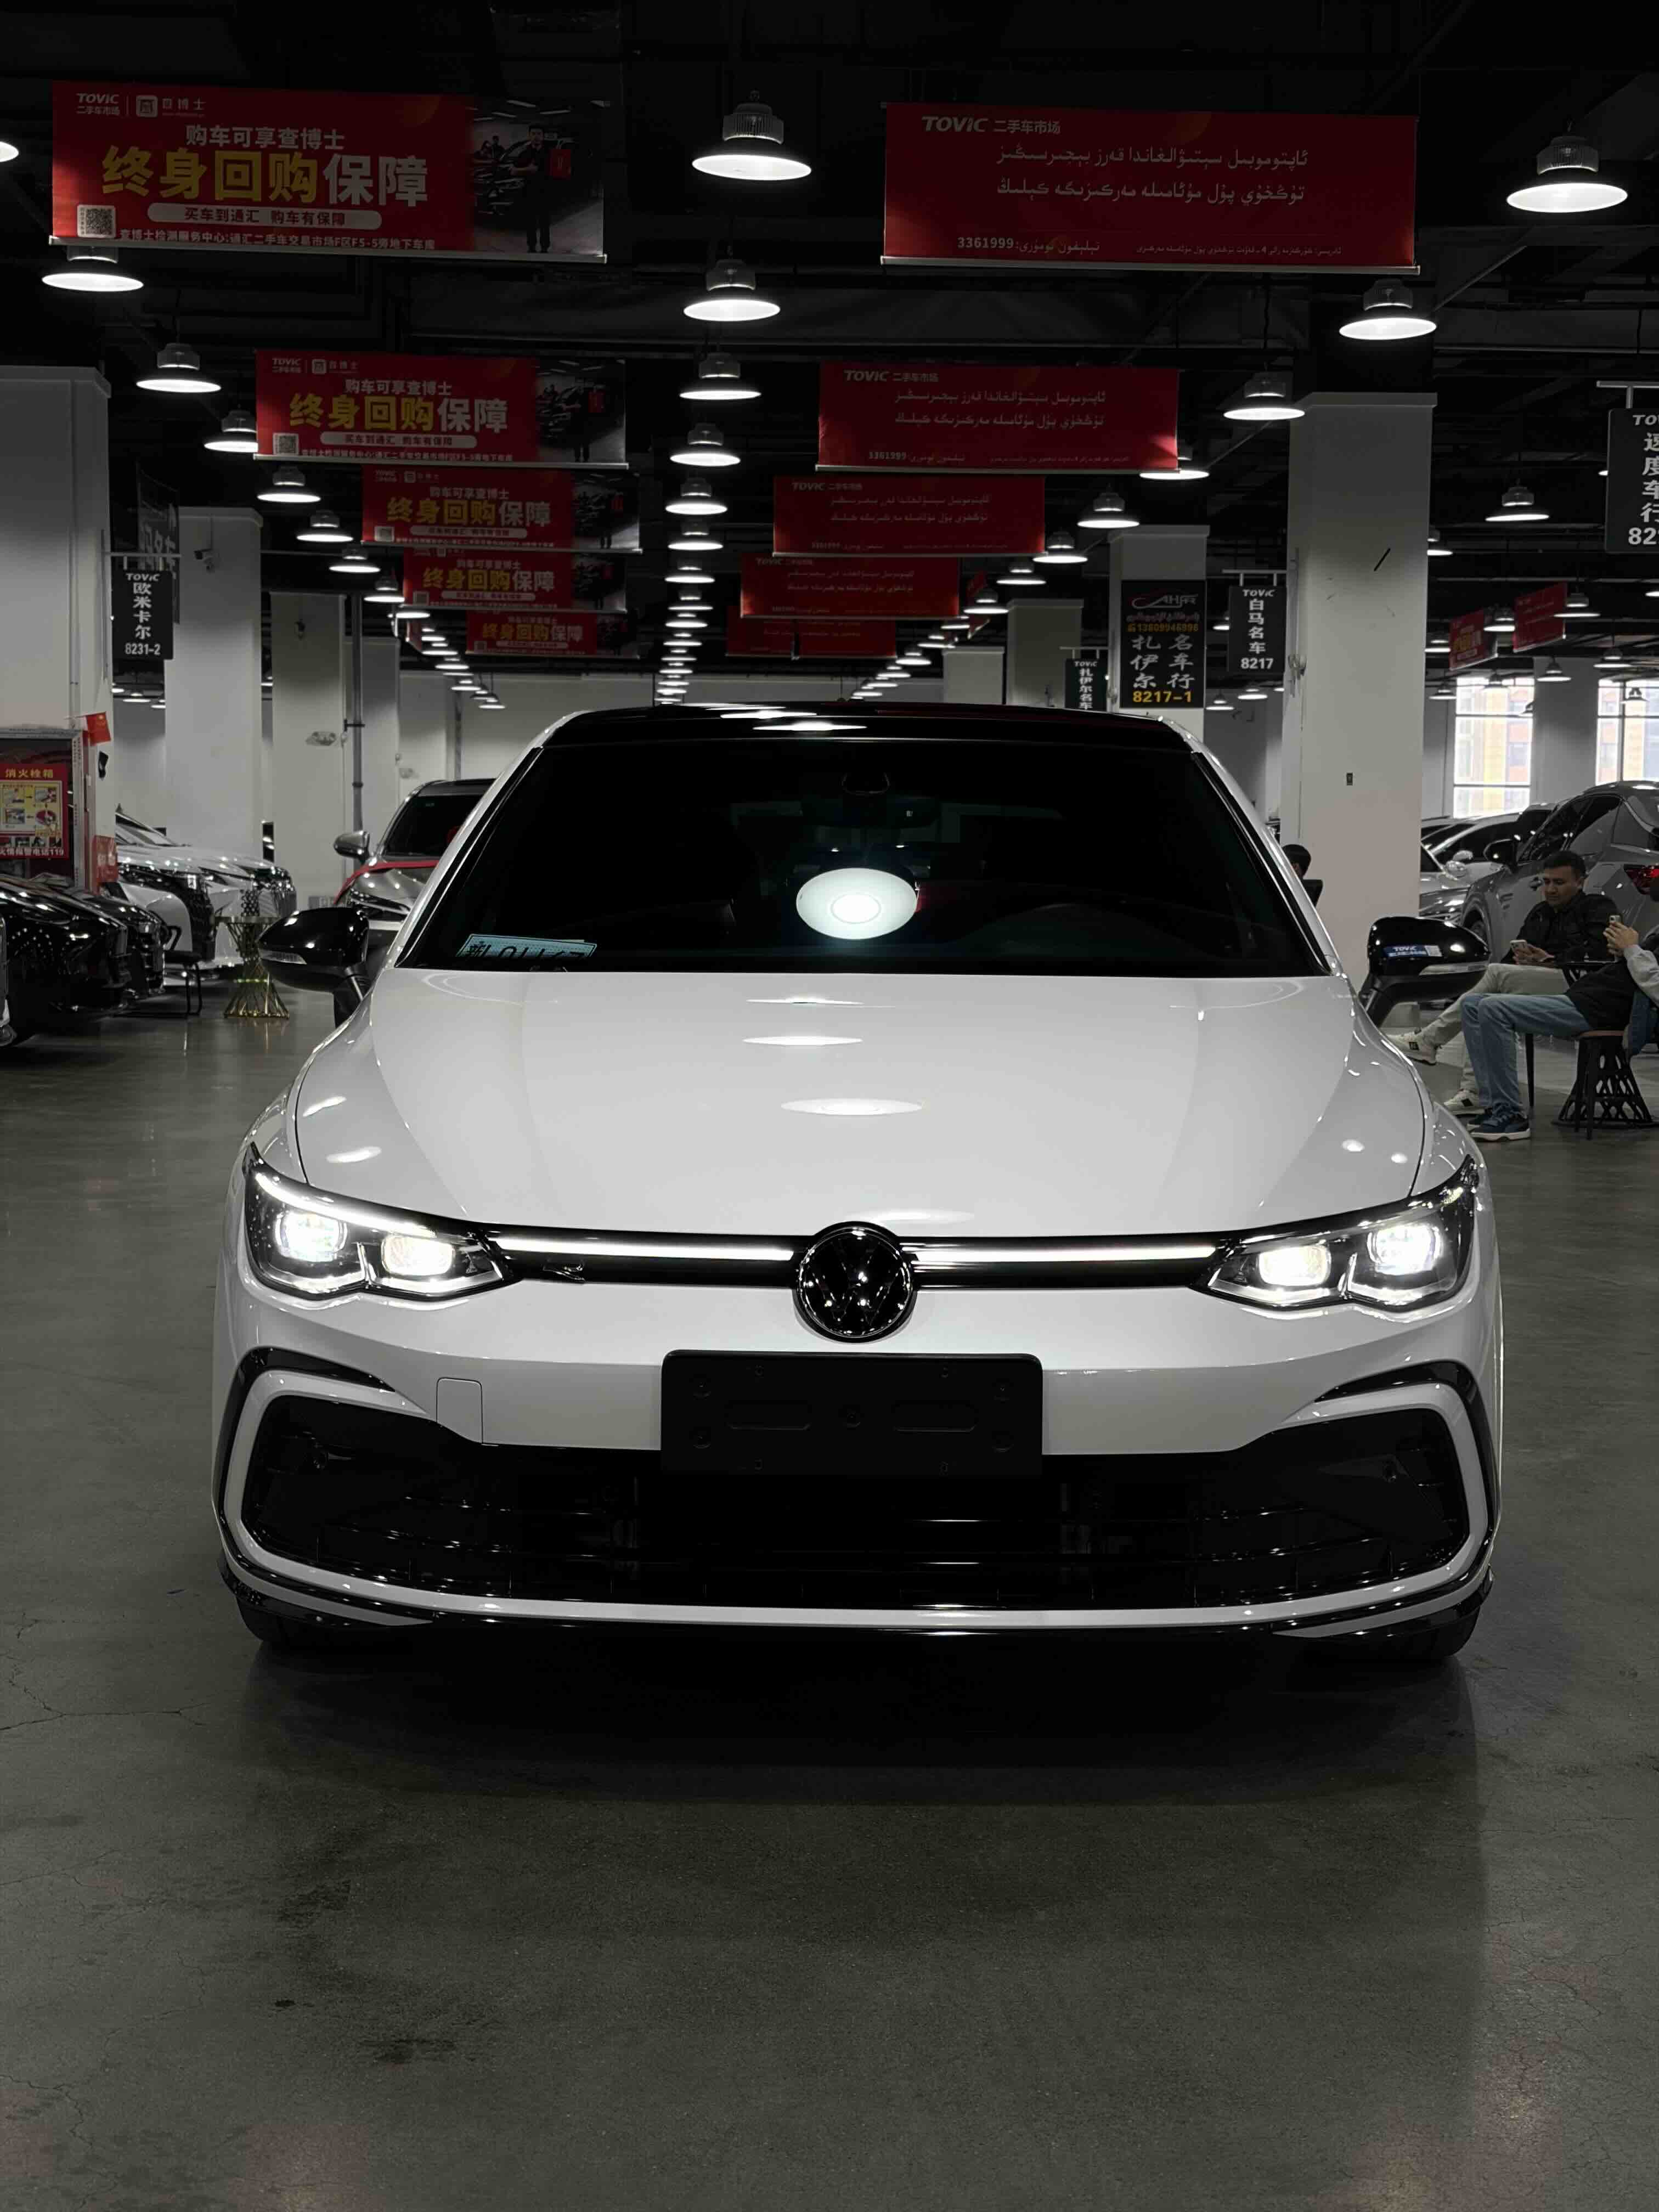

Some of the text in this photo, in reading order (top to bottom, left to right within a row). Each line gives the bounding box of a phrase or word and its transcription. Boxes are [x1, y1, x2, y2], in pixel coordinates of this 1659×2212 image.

[75, 93, 119, 104] TOVIC
[921, 116, 1061, 134] TOVIC 二手车市场
[185, 124, 346, 151] 购车可享查博士
[101, 145, 428, 207] 终身回购保障
[957, 237, 1014, 249] 3361999
[844, 369, 889, 382] TOVIC
[345, 379, 453, 396] 购车可享查博士
[289, 392, 508, 434] 终身回购保障
[1632, 414, 1659, 426] TO
[386, 495, 551, 527] 终身回购保障
[1628, 527, 1659, 545] 82
[126, 573, 161, 582] TOVIC
[422, 567, 555, 594] 终身回购保障
[1242, 589, 1276, 597] TOVIC
[132, 582, 152, 640] 欧米卡尔
[1248, 599, 1266, 654] 白马名车
[125, 643, 161, 656] 8231-2
[1240, 658, 1274, 670] 8217
[1132, 691, 1192, 703] 8217-1
